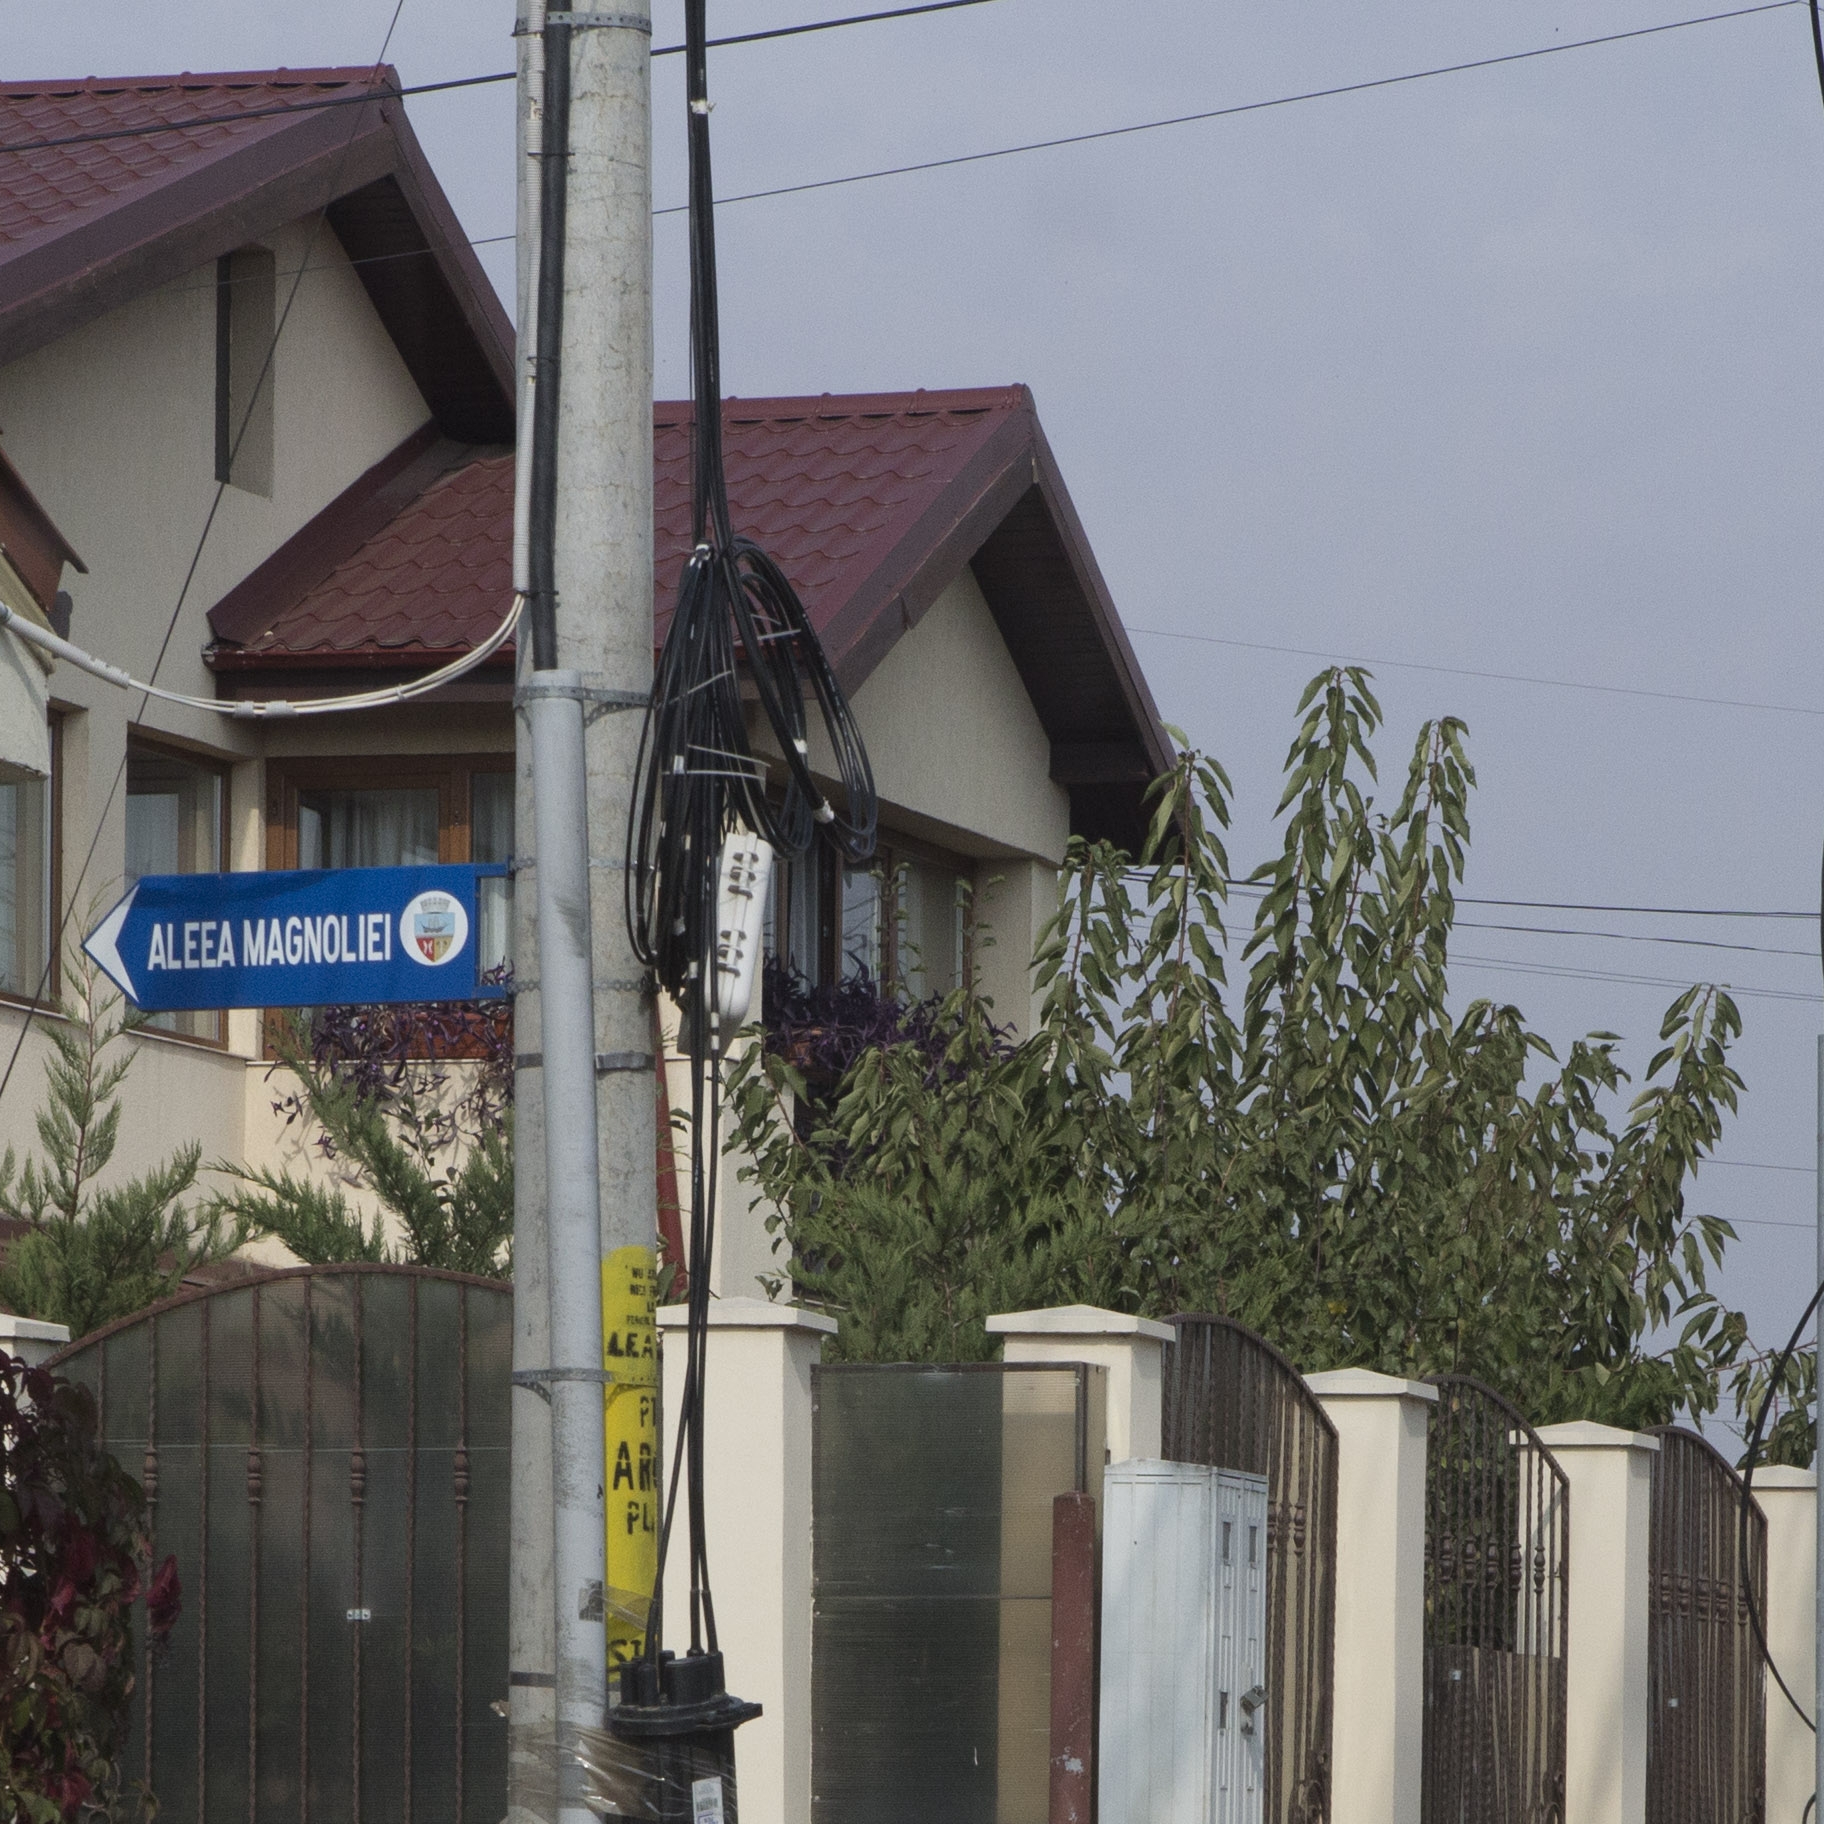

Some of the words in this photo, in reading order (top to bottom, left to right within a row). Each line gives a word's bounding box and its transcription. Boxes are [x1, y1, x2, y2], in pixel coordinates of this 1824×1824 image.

[147, 920, 236, 970] ALEEA
[243, 913, 391, 966] MAGNOLIEI
[607, 1331, 653, 1357] LEA
